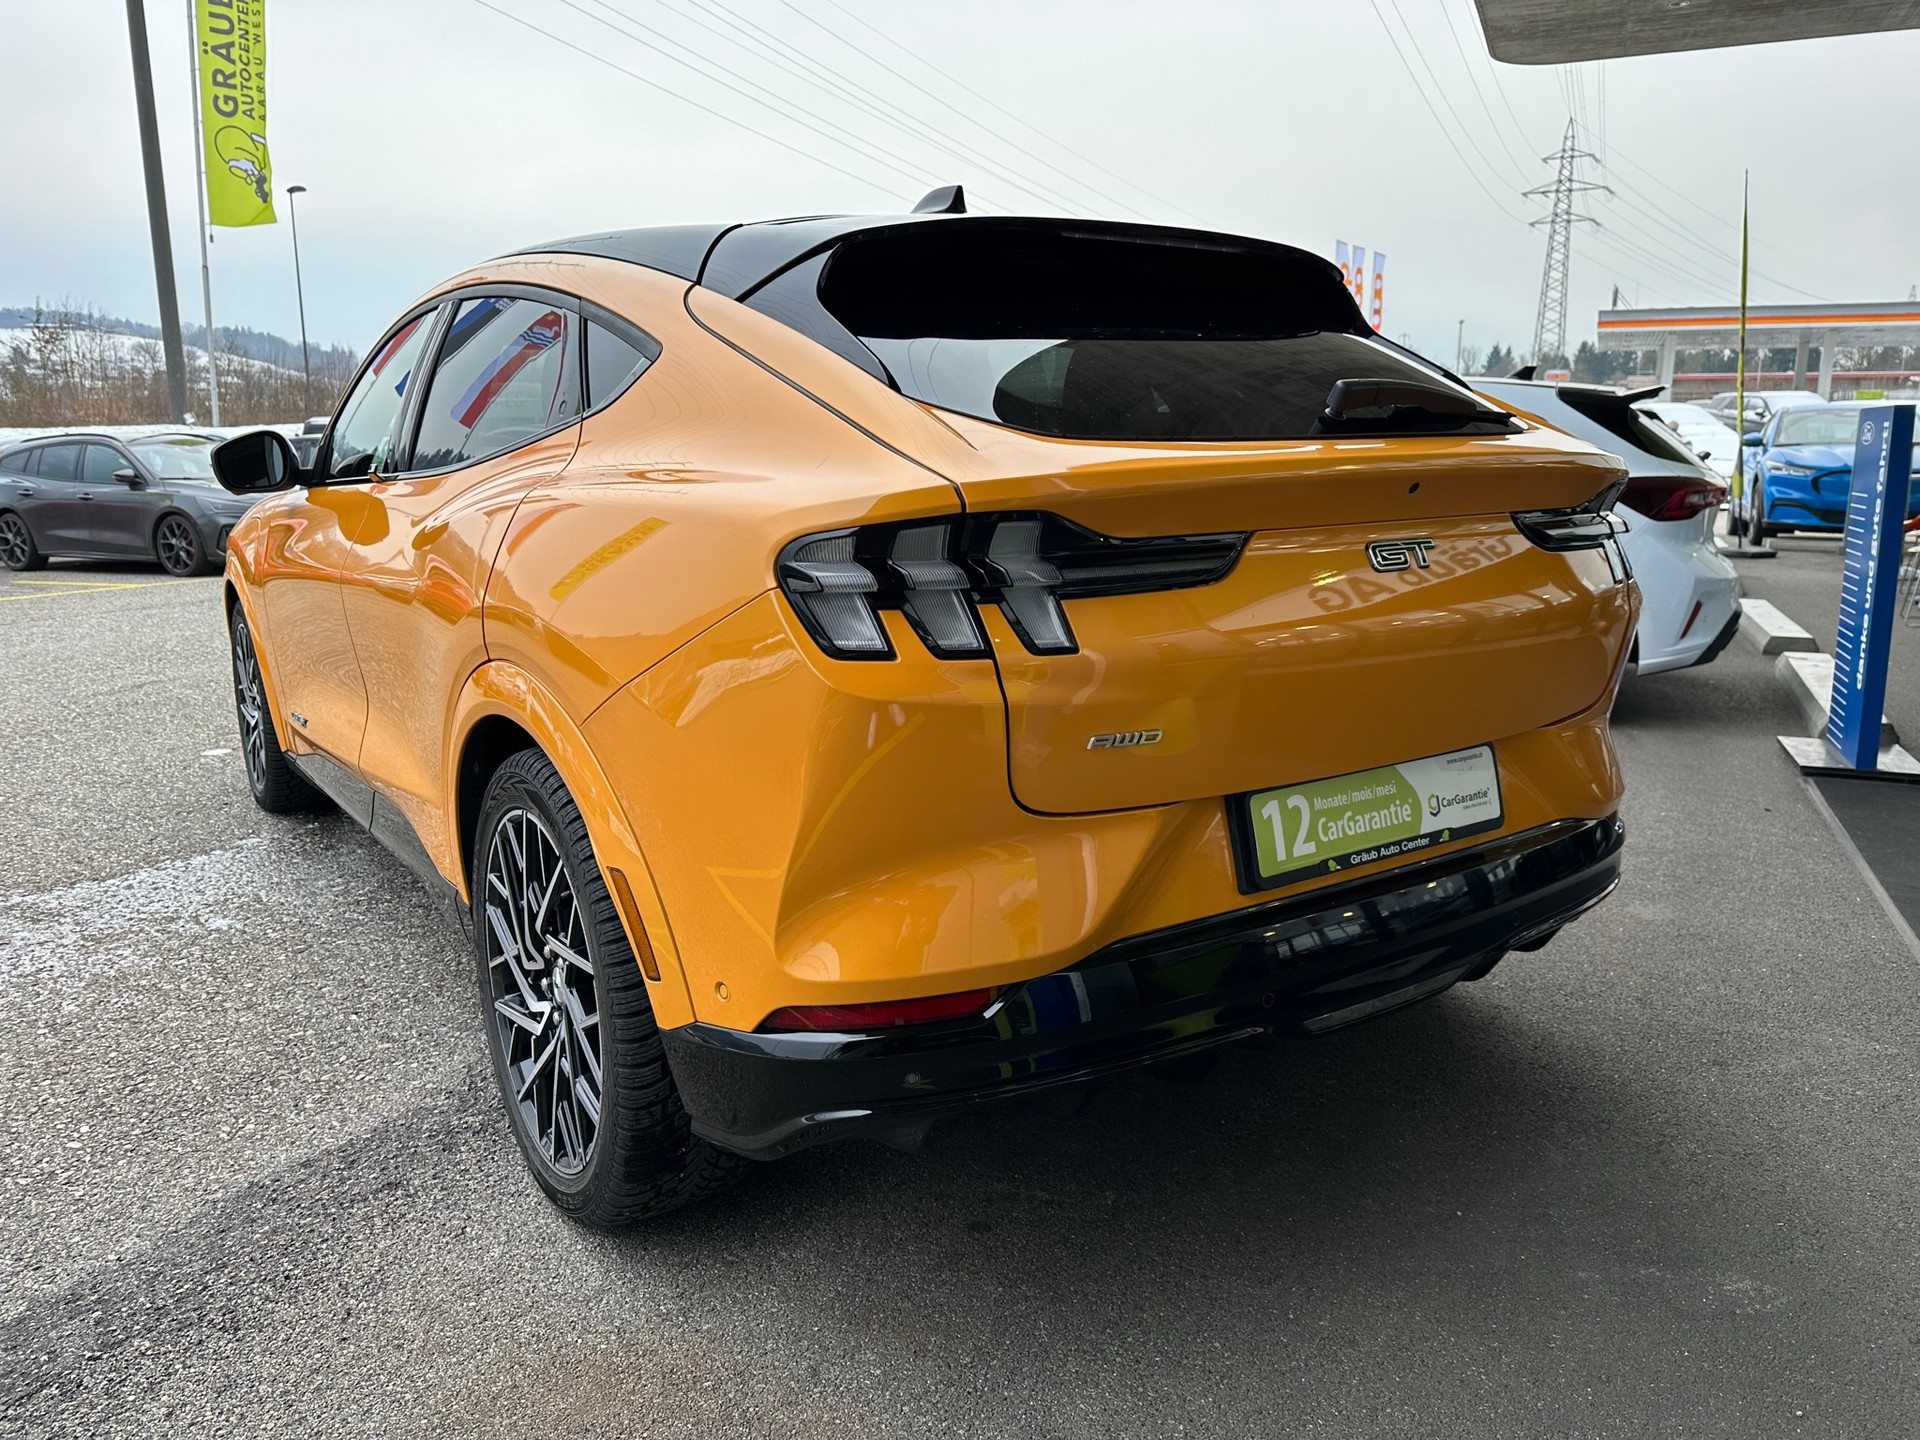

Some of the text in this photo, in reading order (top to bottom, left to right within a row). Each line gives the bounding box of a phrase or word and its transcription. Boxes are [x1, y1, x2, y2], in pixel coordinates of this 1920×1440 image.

[253, 57, 266, 121] AARAU
[1365, 537, 1435, 573] GT
[1856, 421, 1890, 690] danke und gute fahrt!
[1086, 729, 1163, 750] AWD
[1261, 794, 1317, 862] 12
[1350, 836, 1430, 865] Gräub Auto Center
